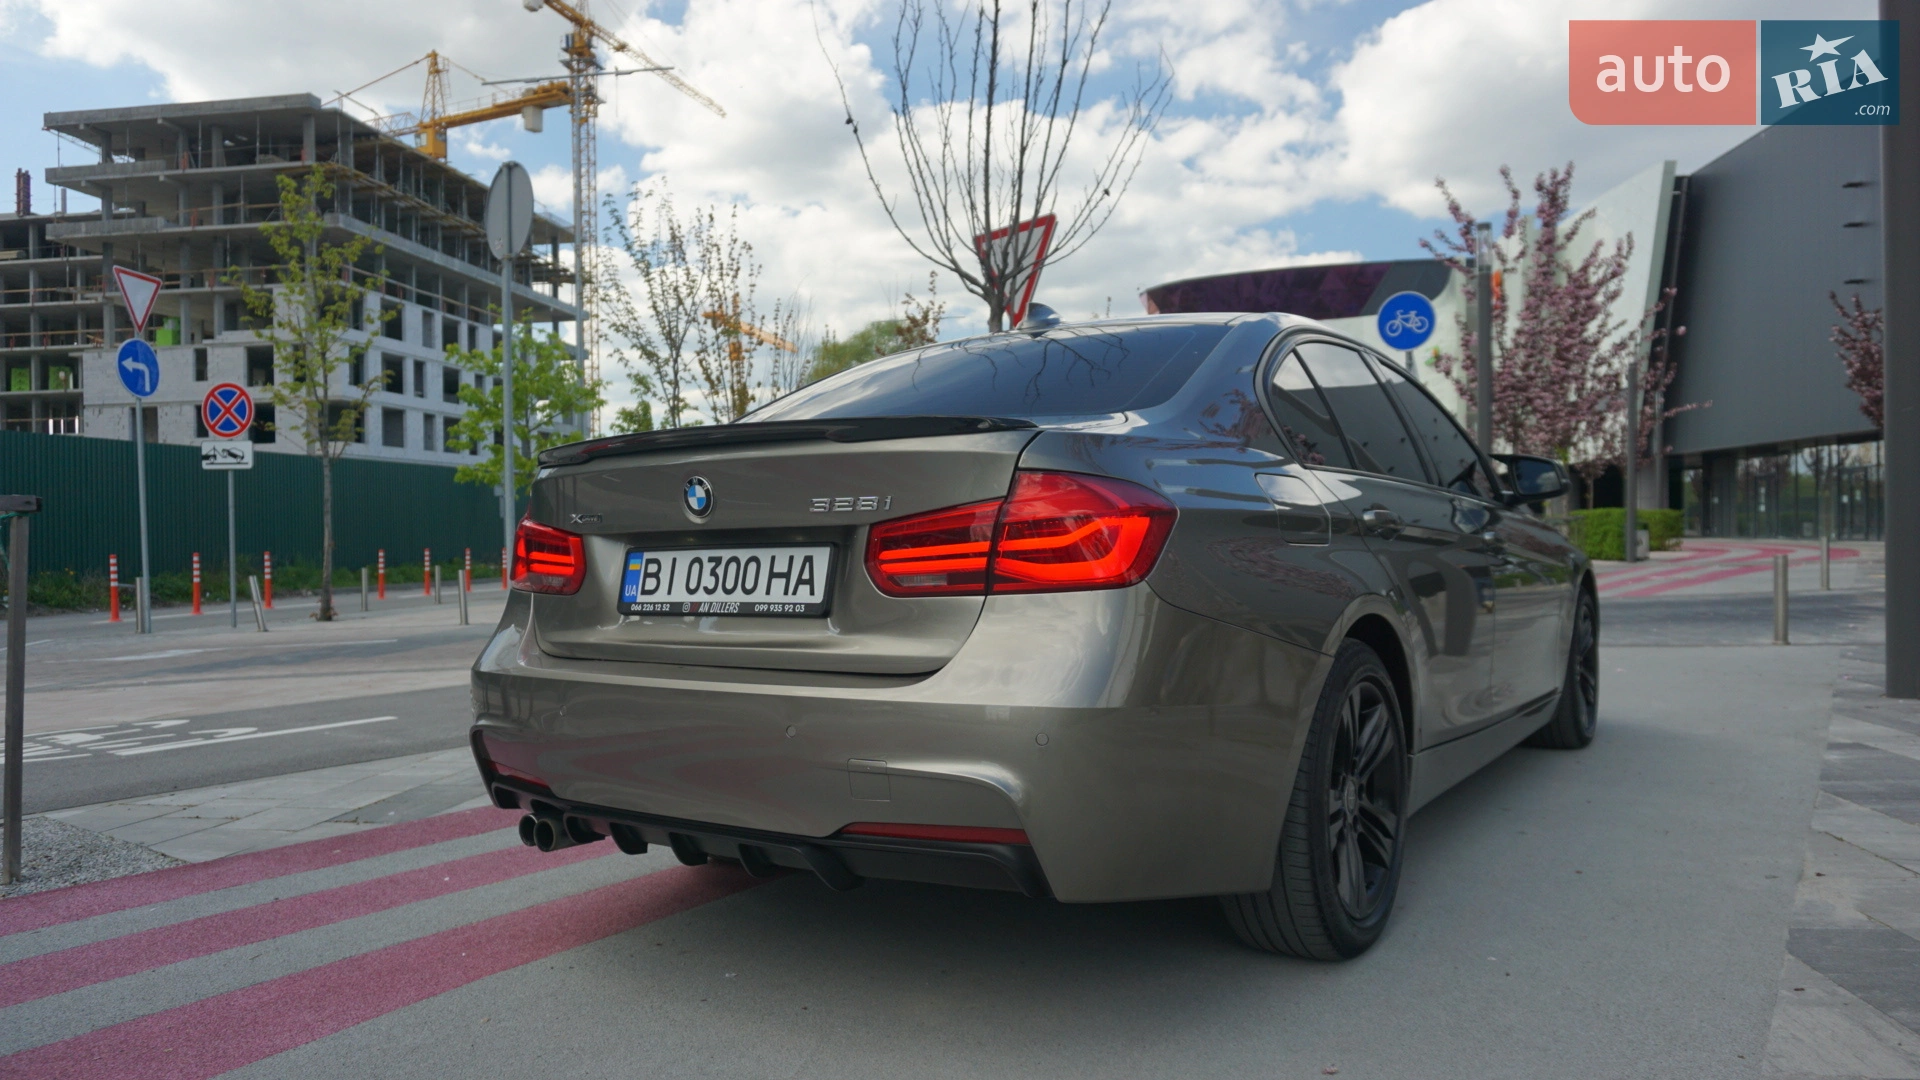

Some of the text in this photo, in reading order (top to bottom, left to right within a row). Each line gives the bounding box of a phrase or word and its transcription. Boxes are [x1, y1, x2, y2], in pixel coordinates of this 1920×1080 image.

[809, 495, 892, 513] 328i
[640, 554, 815, 596] BI 0300 HA
[625, 584, 637, 597] UA
[643, 603, 654, 611] 226
[655, 603, 662, 611] 12
[662, 603, 670, 611] 52
[709, 602, 740, 614] DILLERS
[754, 604, 805, 613] 099 935 92 03
